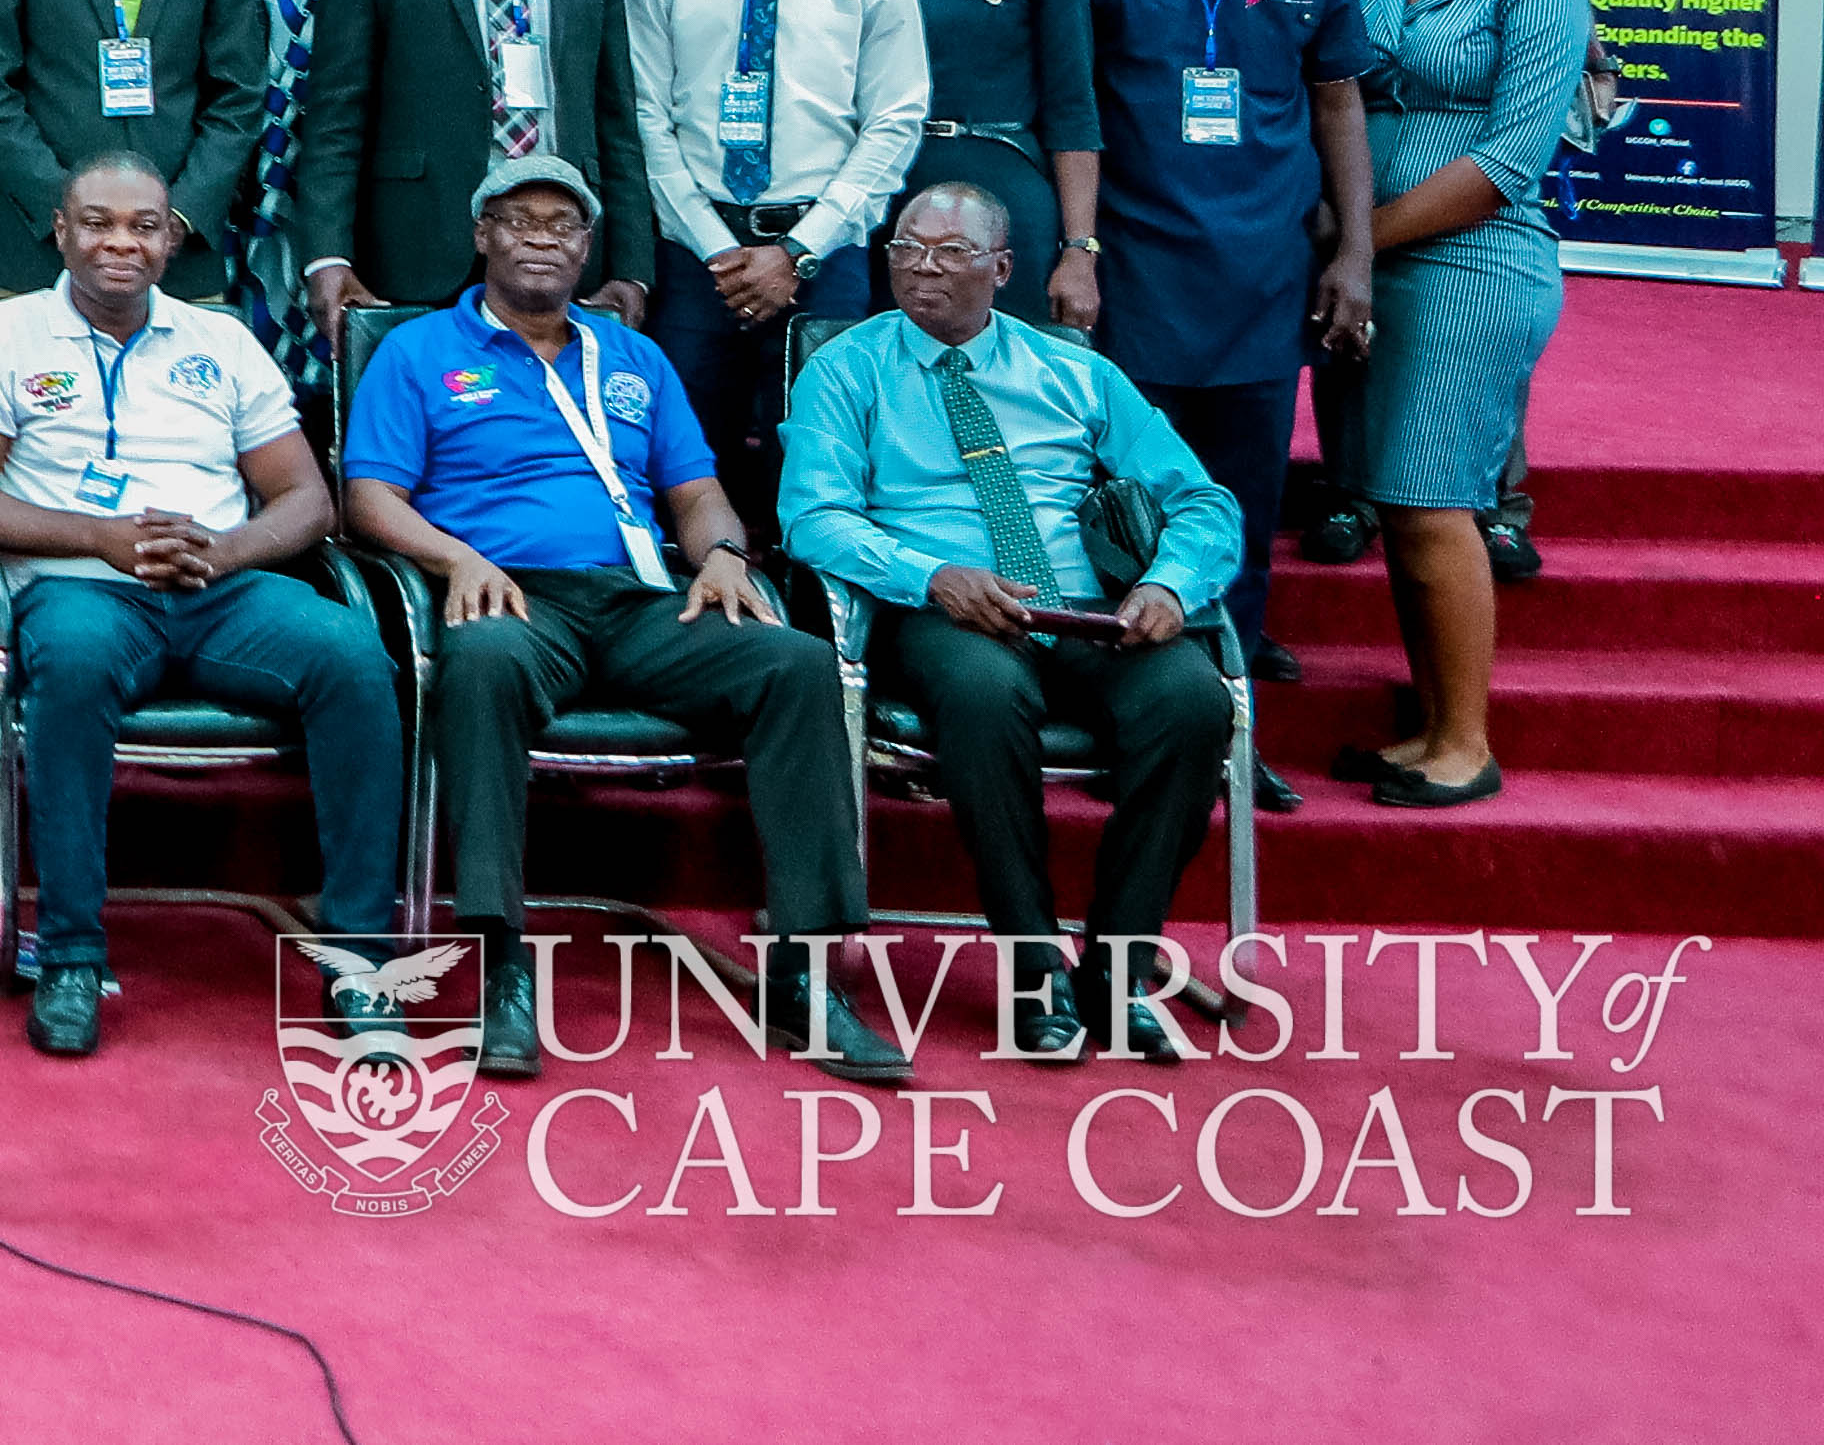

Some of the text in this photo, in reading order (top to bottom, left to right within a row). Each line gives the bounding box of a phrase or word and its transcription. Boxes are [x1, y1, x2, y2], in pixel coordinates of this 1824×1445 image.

[1594, 23, 1765, 51] Expanding the
[1586, 199, 1670, 215] Competitive
[1673, 204, 1719, 218] Choice
